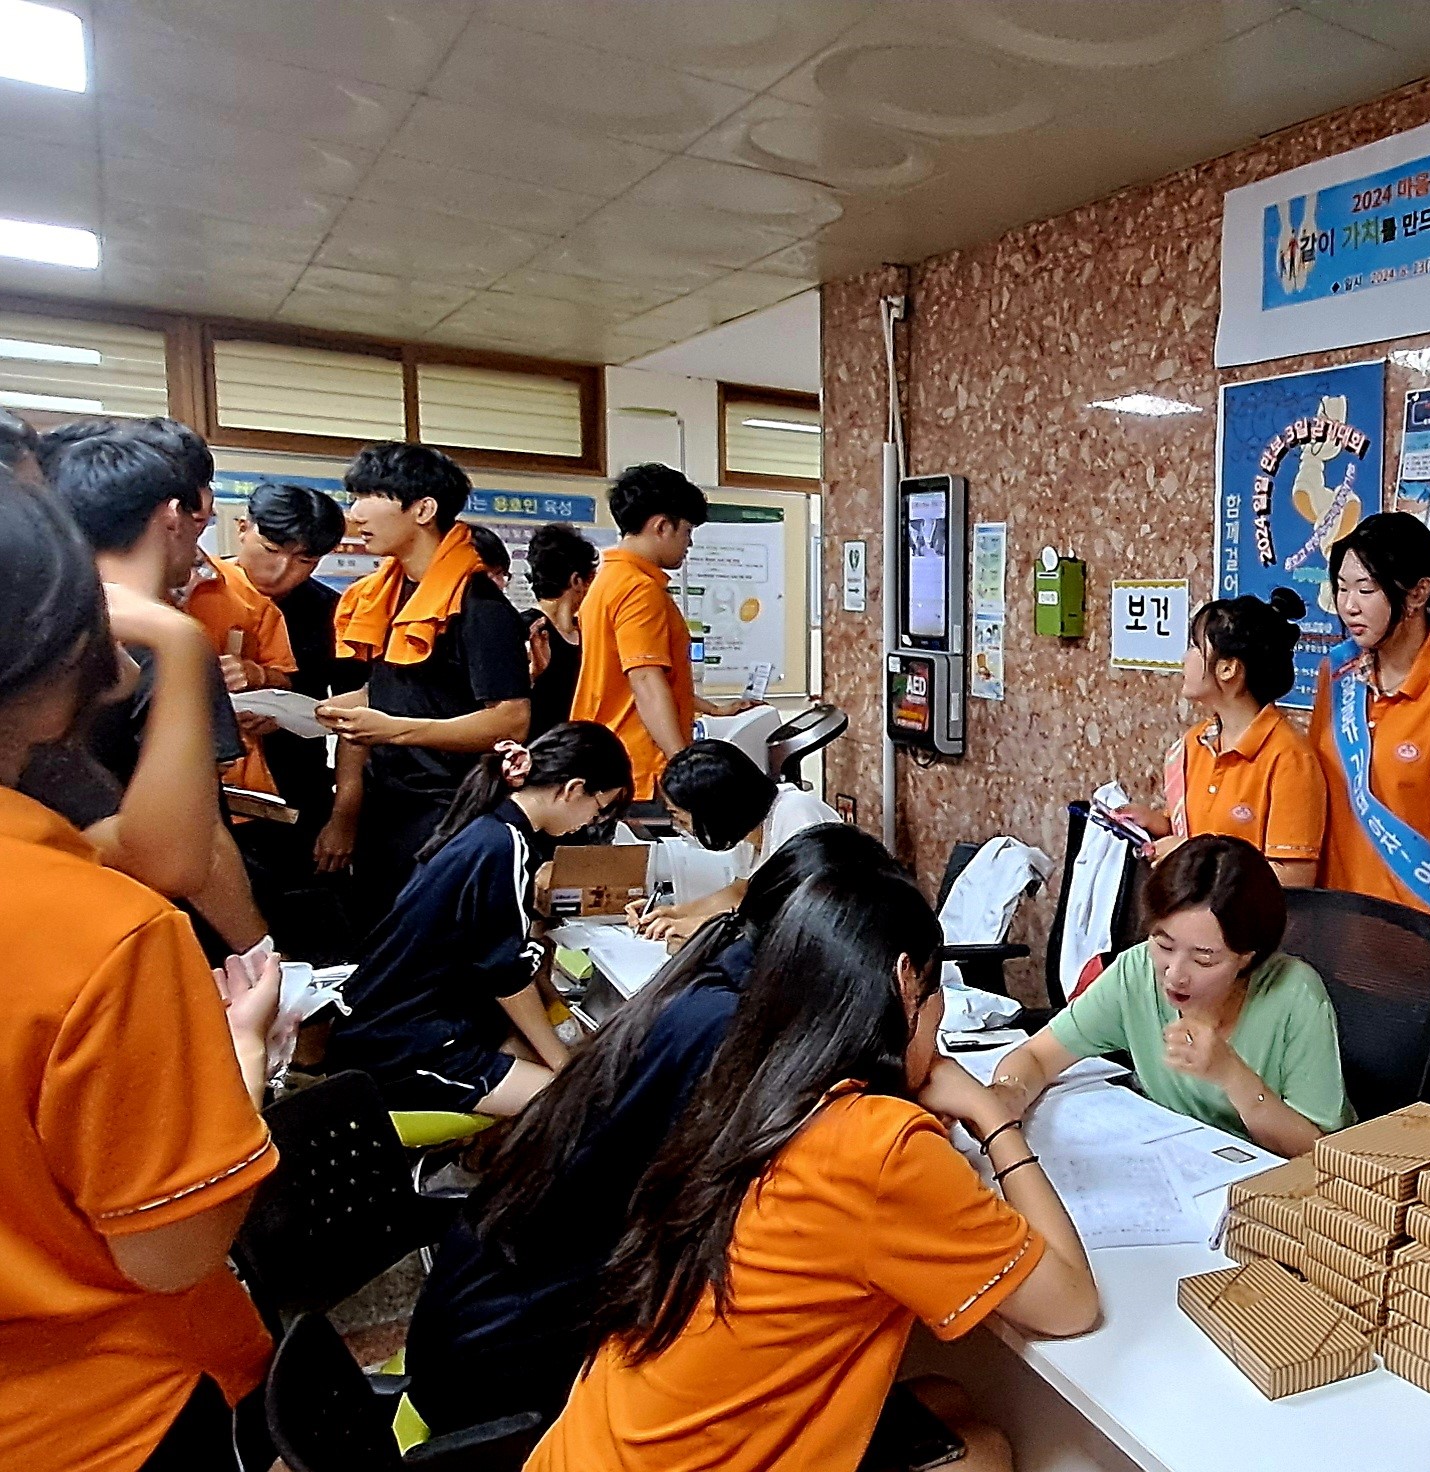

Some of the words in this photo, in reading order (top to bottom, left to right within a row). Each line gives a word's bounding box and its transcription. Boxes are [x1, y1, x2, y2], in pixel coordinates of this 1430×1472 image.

[1353, 184, 1393, 213] 2024
[1300, 229, 1335, 264] 같이
[1342, 215, 1397, 249] 가치를
[544, 499, 572, 517] 육성
[1254, 515, 1275, 565] 2024
[1283, 417, 1309, 443] 3일
[1310, 417, 1368, 456] 걷기대회
[1123, 593, 1172, 638] 보건
[906, 673, 927, 697] AED
